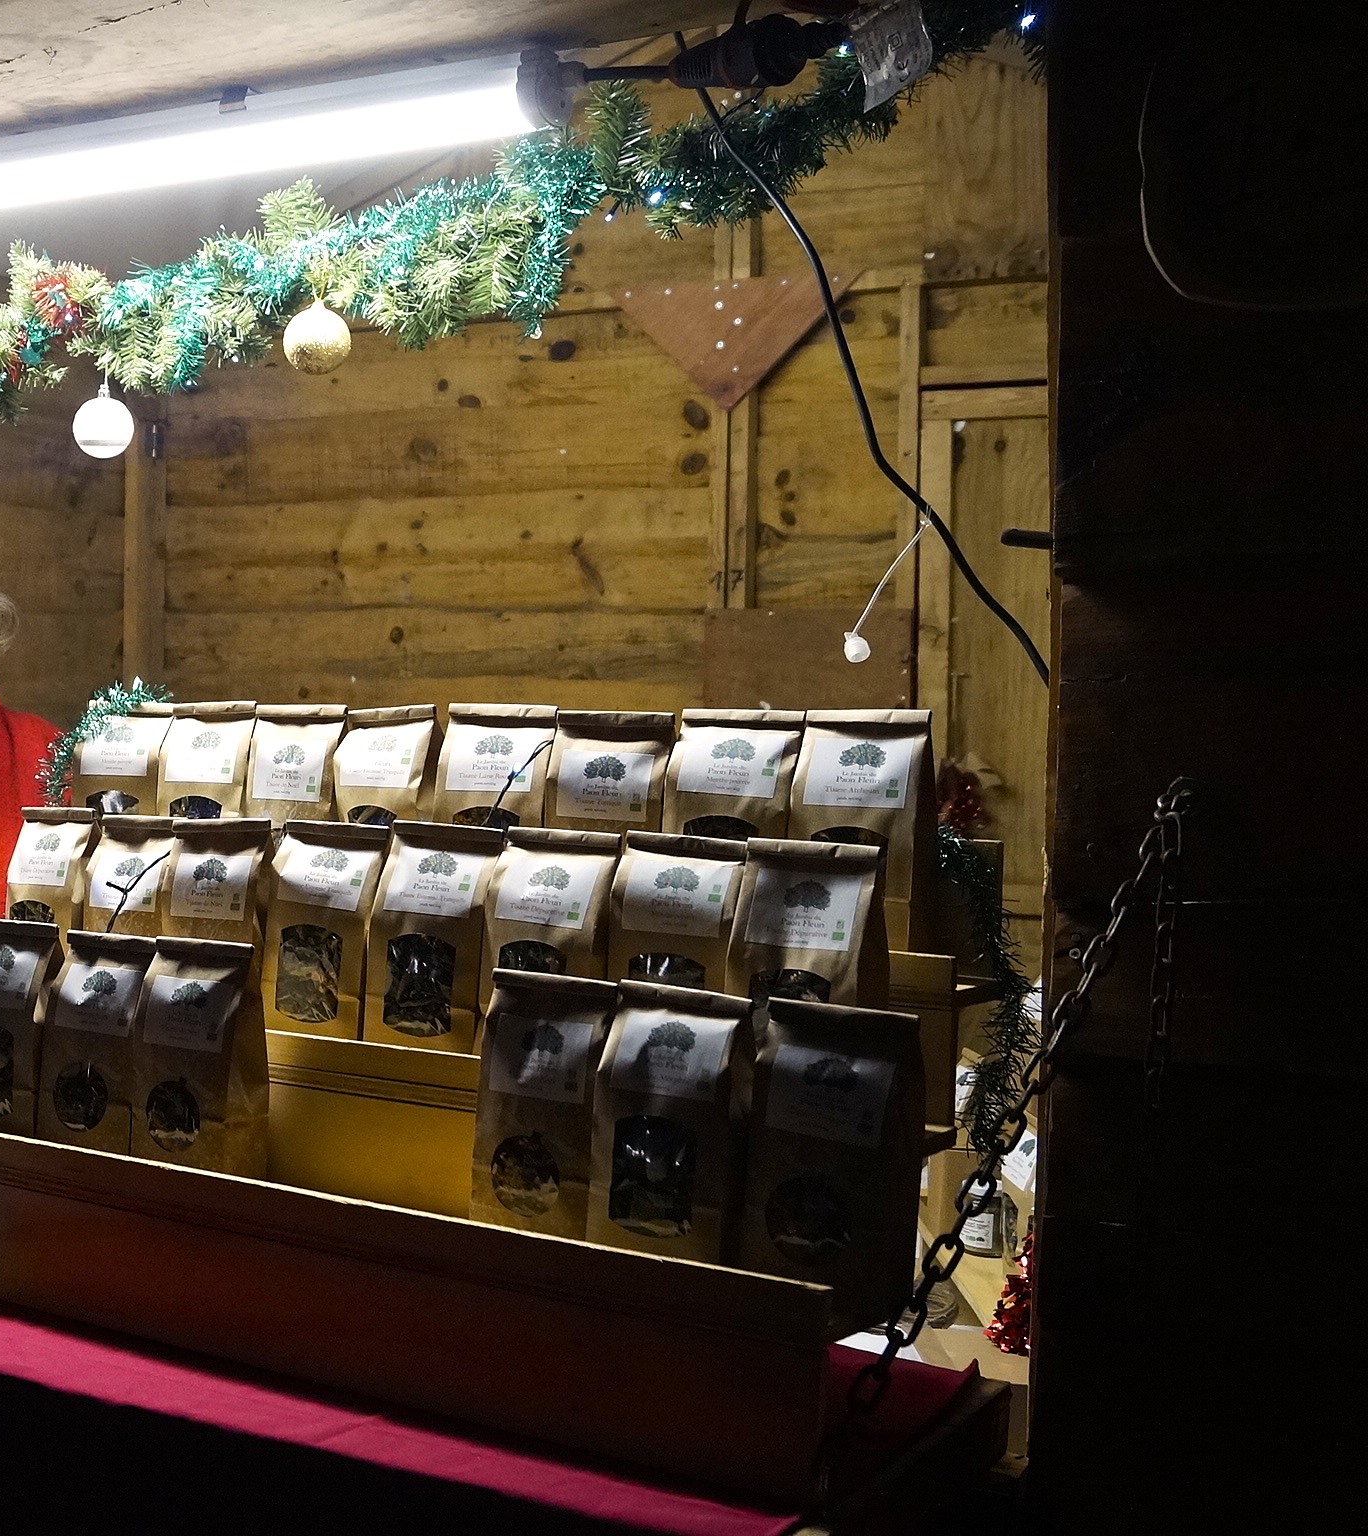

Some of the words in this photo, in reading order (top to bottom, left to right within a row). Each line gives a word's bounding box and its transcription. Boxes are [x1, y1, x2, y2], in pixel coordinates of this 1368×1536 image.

[728, 768, 750, 777] Fleuri
[836, 775, 854, 783] Paon
[857, 776, 880, 784] Fleuri
[304, 875, 320, 884] Paon
[322, 876, 340, 886] Fleuri
[413, 882, 429, 890] Paon
[431, 884, 450, 892] Fleuri
[781, 917, 801, 926] Paon
[803, 918, 826, 928] Fleuri
